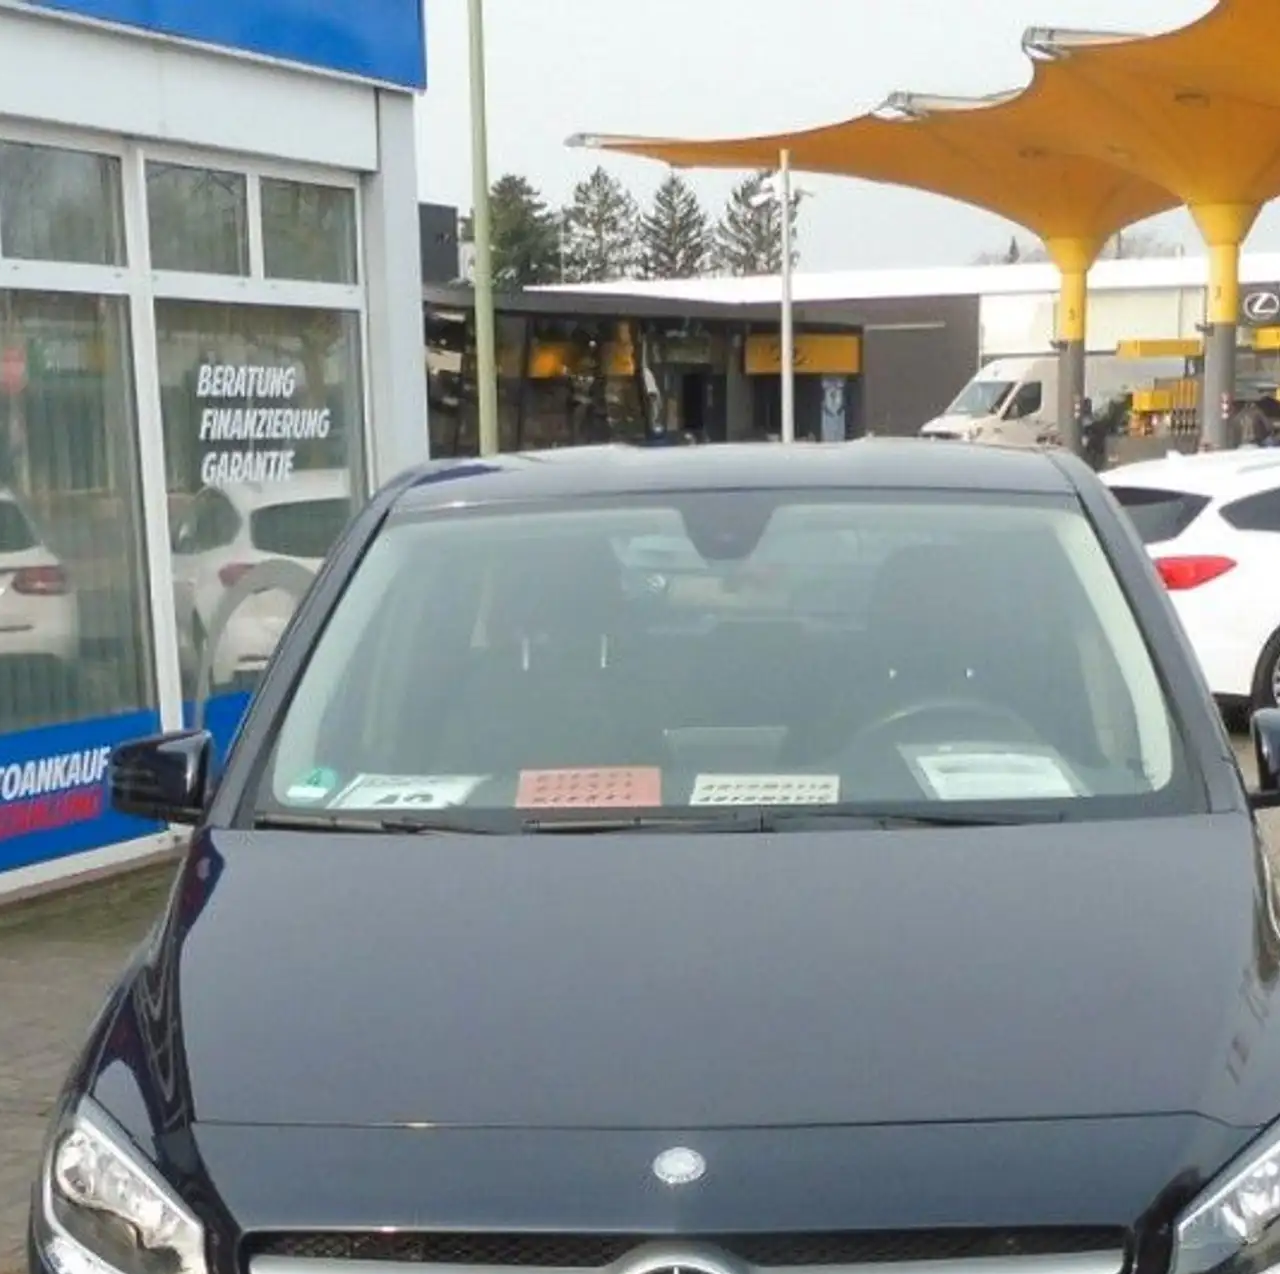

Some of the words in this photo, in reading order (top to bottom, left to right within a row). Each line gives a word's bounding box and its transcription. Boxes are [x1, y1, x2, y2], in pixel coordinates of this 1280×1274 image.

[196, 364, 296, 398] BERATUNG
[199, 408, 331, 440] FINANZIERUNG
[201, 450, 296, 485] GARANTIE
